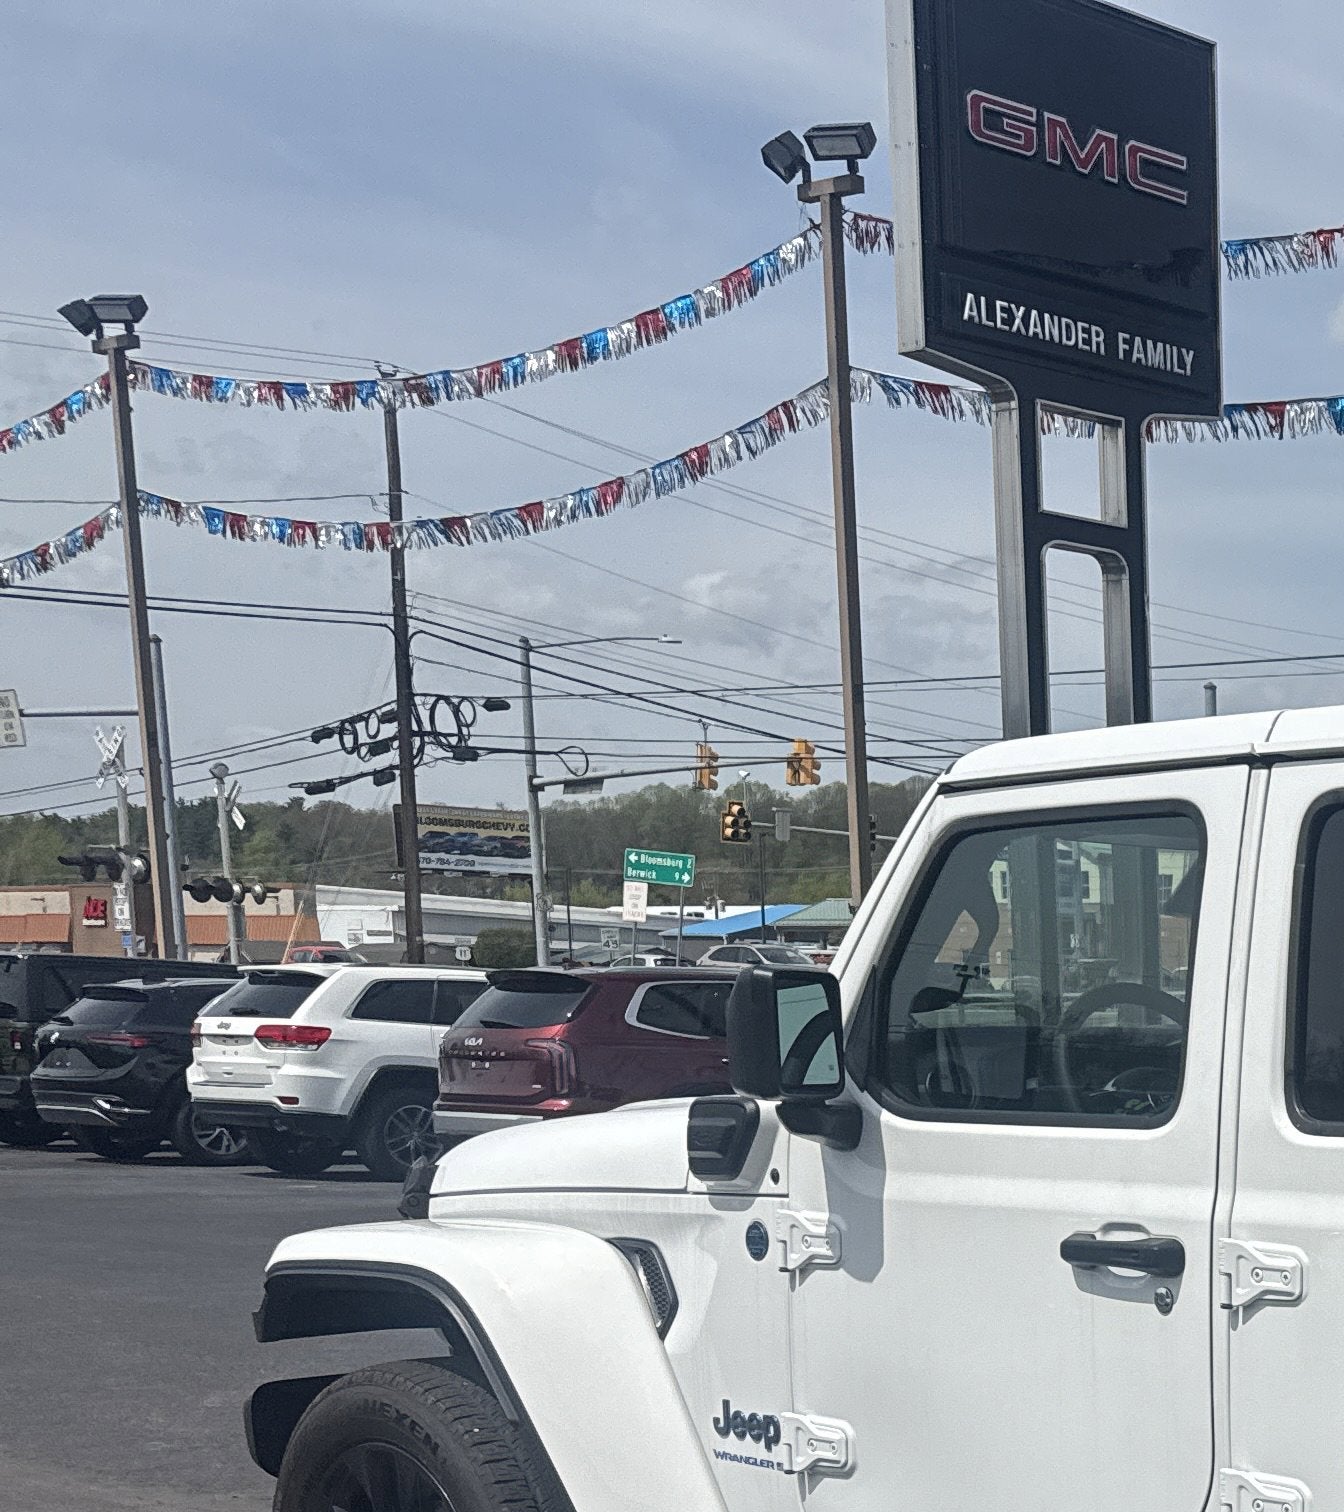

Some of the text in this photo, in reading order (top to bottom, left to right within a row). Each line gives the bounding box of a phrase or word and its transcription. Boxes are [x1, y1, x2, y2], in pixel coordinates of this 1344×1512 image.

[967, 88, 1188, 206] GMC
[962, 293, 1195, 377] ALEXANDER FAMILY
[627, 866, 680, 880] Berwick 9
[640, 854, 692, 869] Bloomsburg 2
[712, 1398, 782, 1454] Jeep
[712, 1448, 775, 1471] WRANGLER
